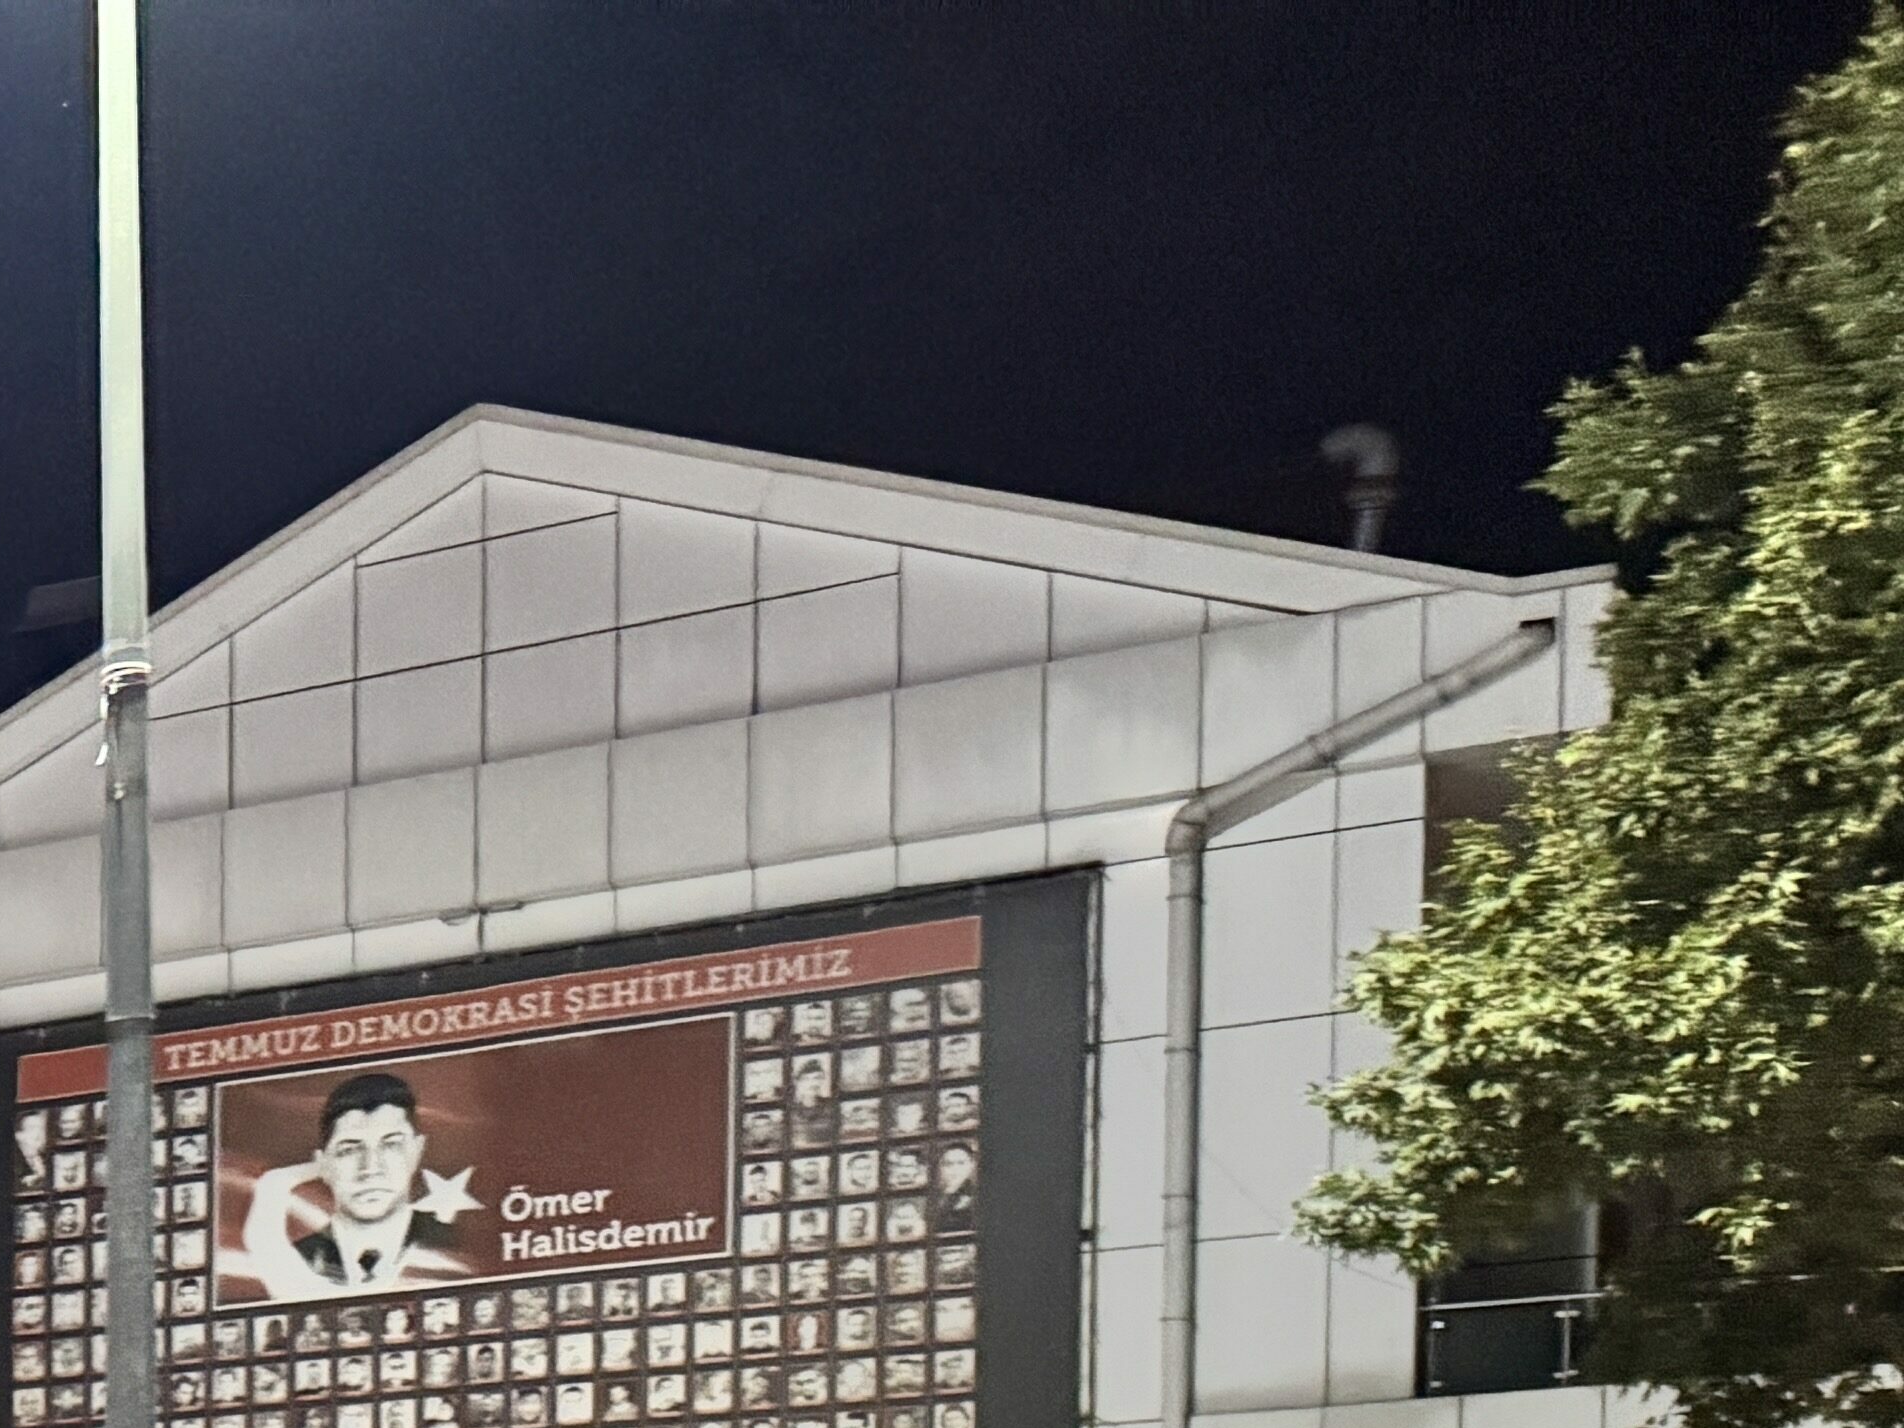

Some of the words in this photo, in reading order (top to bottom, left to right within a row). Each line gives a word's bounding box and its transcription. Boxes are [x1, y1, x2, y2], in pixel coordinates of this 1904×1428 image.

[163, 1029, 322, 1072] TEMMUZ
[330, 984, 553, 1049] DEMOKRASİ
[563, 946, 853, 1025] ŞEHİTLERİMİZ
[500, 1185, 613, 1222] Ömer
[500, 1212, 715, 1262] Halisdemir
